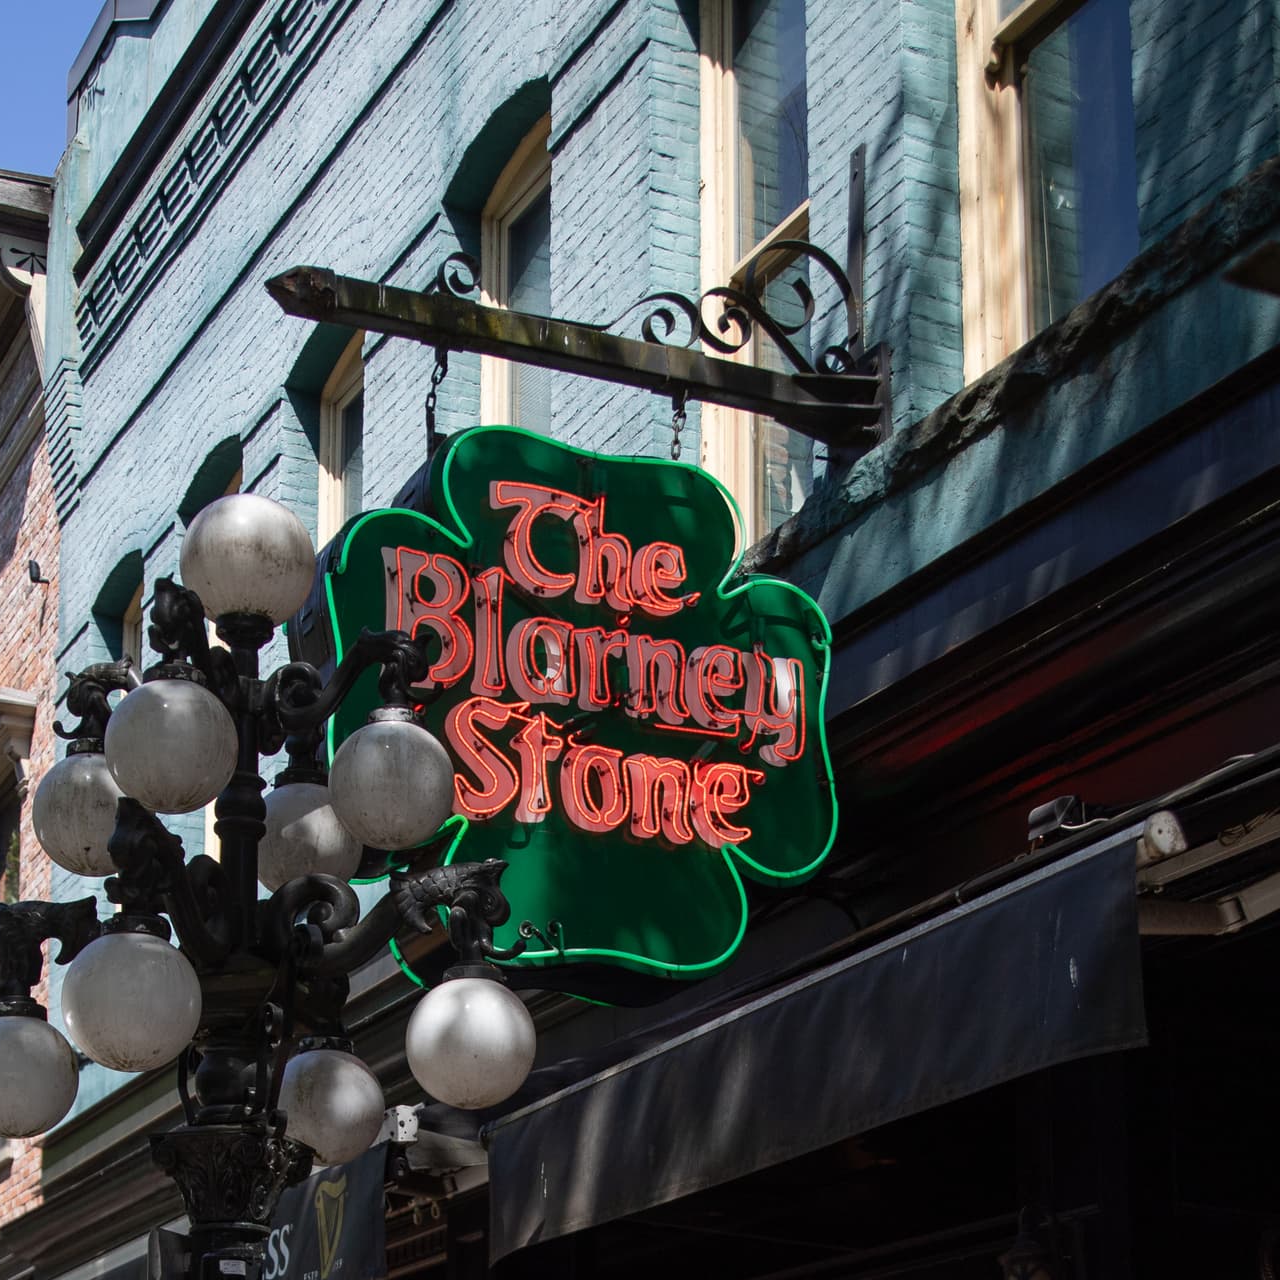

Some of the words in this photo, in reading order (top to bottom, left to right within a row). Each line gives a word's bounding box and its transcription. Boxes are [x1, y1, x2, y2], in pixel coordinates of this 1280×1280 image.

[489, 480, 701, 616] The
[380, 546, 806, 767] Blarney
[444, 696, 766, 850] Stone
